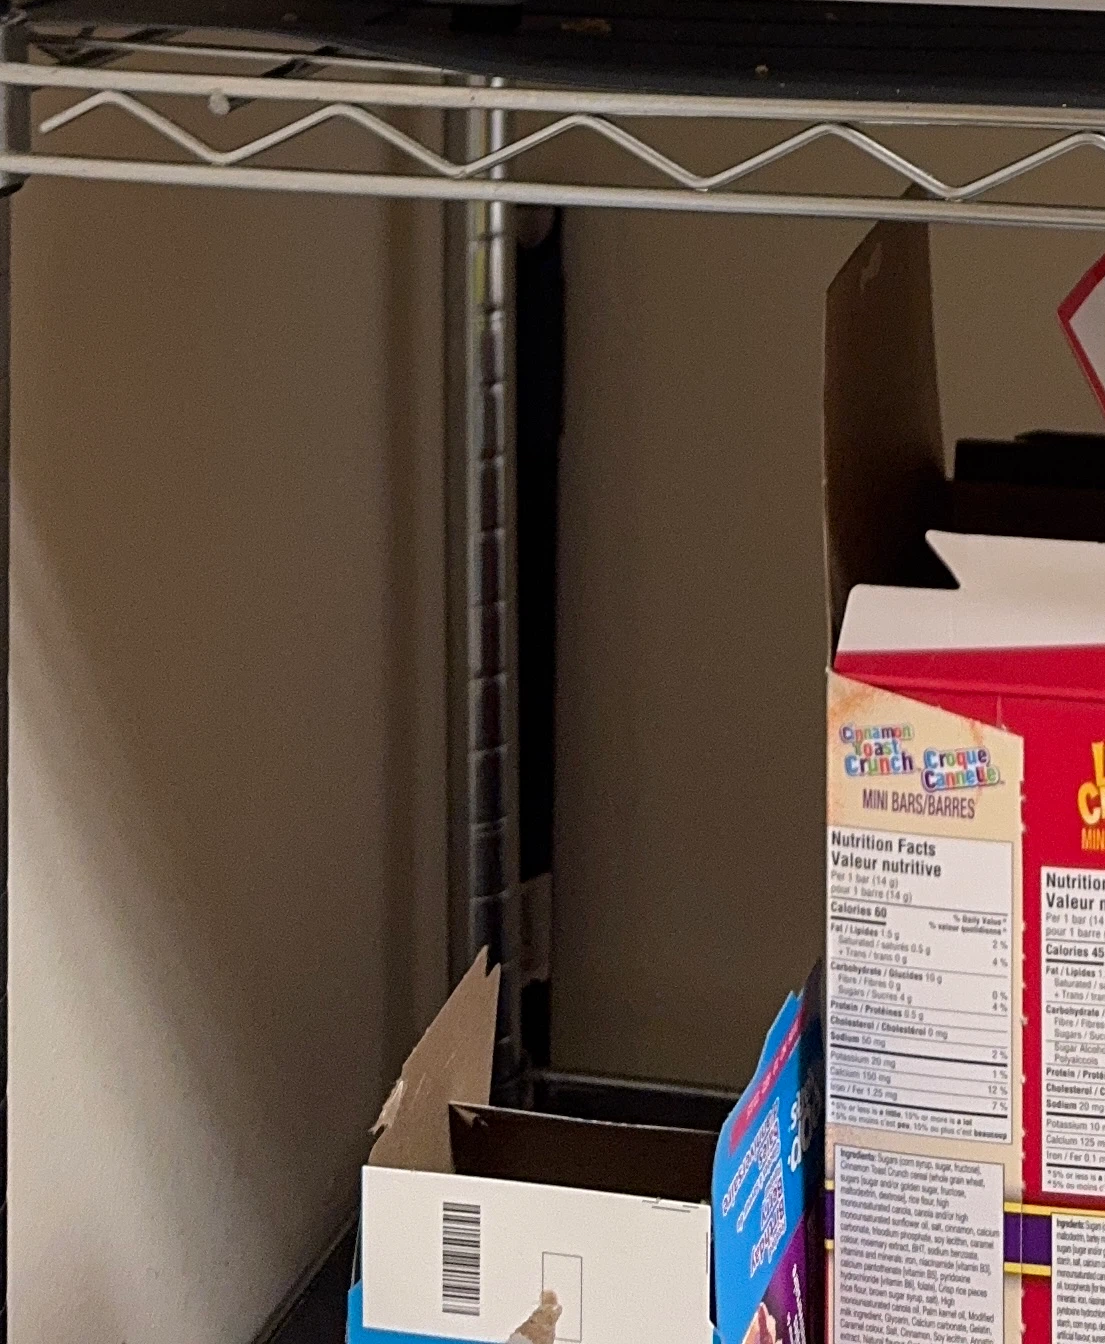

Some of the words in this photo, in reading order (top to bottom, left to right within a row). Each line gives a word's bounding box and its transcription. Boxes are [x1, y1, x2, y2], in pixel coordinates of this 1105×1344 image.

[853, 740, 900, 757] Toast
[845, 751, 916, 777] Crunch
[924, 746, 990, 769] Croque
[863, 788, 888, 810] MINI
[892, 791, 975, 819] BARS/BARRES
[831, 831, 893, 852] Nutrition
[898, 838, 936, 857] Facts
[831, 851, 877, 869] Valeur
[883, 860, 942, 877] nutritive
[831, 871, 845, 881] Per
[855, 873, 870, 883] bar
[872, 874, 887, 886] (14
[861, 886, 883, 899] barre
[886, 889, 900, 901] (14
[1046, 893, 1094, 911] Valeur
[831, 902, 871, 916] Calories
[1046, 913, 1060, 923] Per
[1065, 914, 1068, 924] 1
[1072, 914, 1086, 925] bar
[1089, 915, 1104, 926] (14
[831, 923, 842, 932] Fat
[851, 925, 878, 938] Lipides
[1046, 928, 1066, 937] pour
[1070, 927, 1074, 936] 1
[1078, 928, 1100, 939] barre
[1046, 944, 1088, 957] Calories
[1092, 947, 1104, 958] 45
[1046, 966, 1059, 975] Fat
[1066, 968, 1095, 979] Lipides
[1062, 990, 1084, 1000] Trans
[831, 1000, 858, 1012] Protein
[1046, 1005, 1099, 1017] Carbohydrate
[1054, 1017, 1073, 1027] Fibre
[1046, 1067, 1075, 1078] Protein
[988, 1085, 998, 1094] 12
[1046, 1083, 1092, 1095] Cholesterol
[1046, 1099, 1077, 1110] Sodium
[1079, 1102, 1089, 1111] 20
[1092, 1105, 1104, 1113] mg
[1046, 1119, 1087, 1130] Potassium
[1090, 1122, 1100, 1131] 10
[1046, 1135, 1077, 1146] Calcium
[1080, 1137, 1095, 1147] 125
[1046, 1150, 1062, 1160] Iron
[1070, 1152, 1082, 1162] Fer
